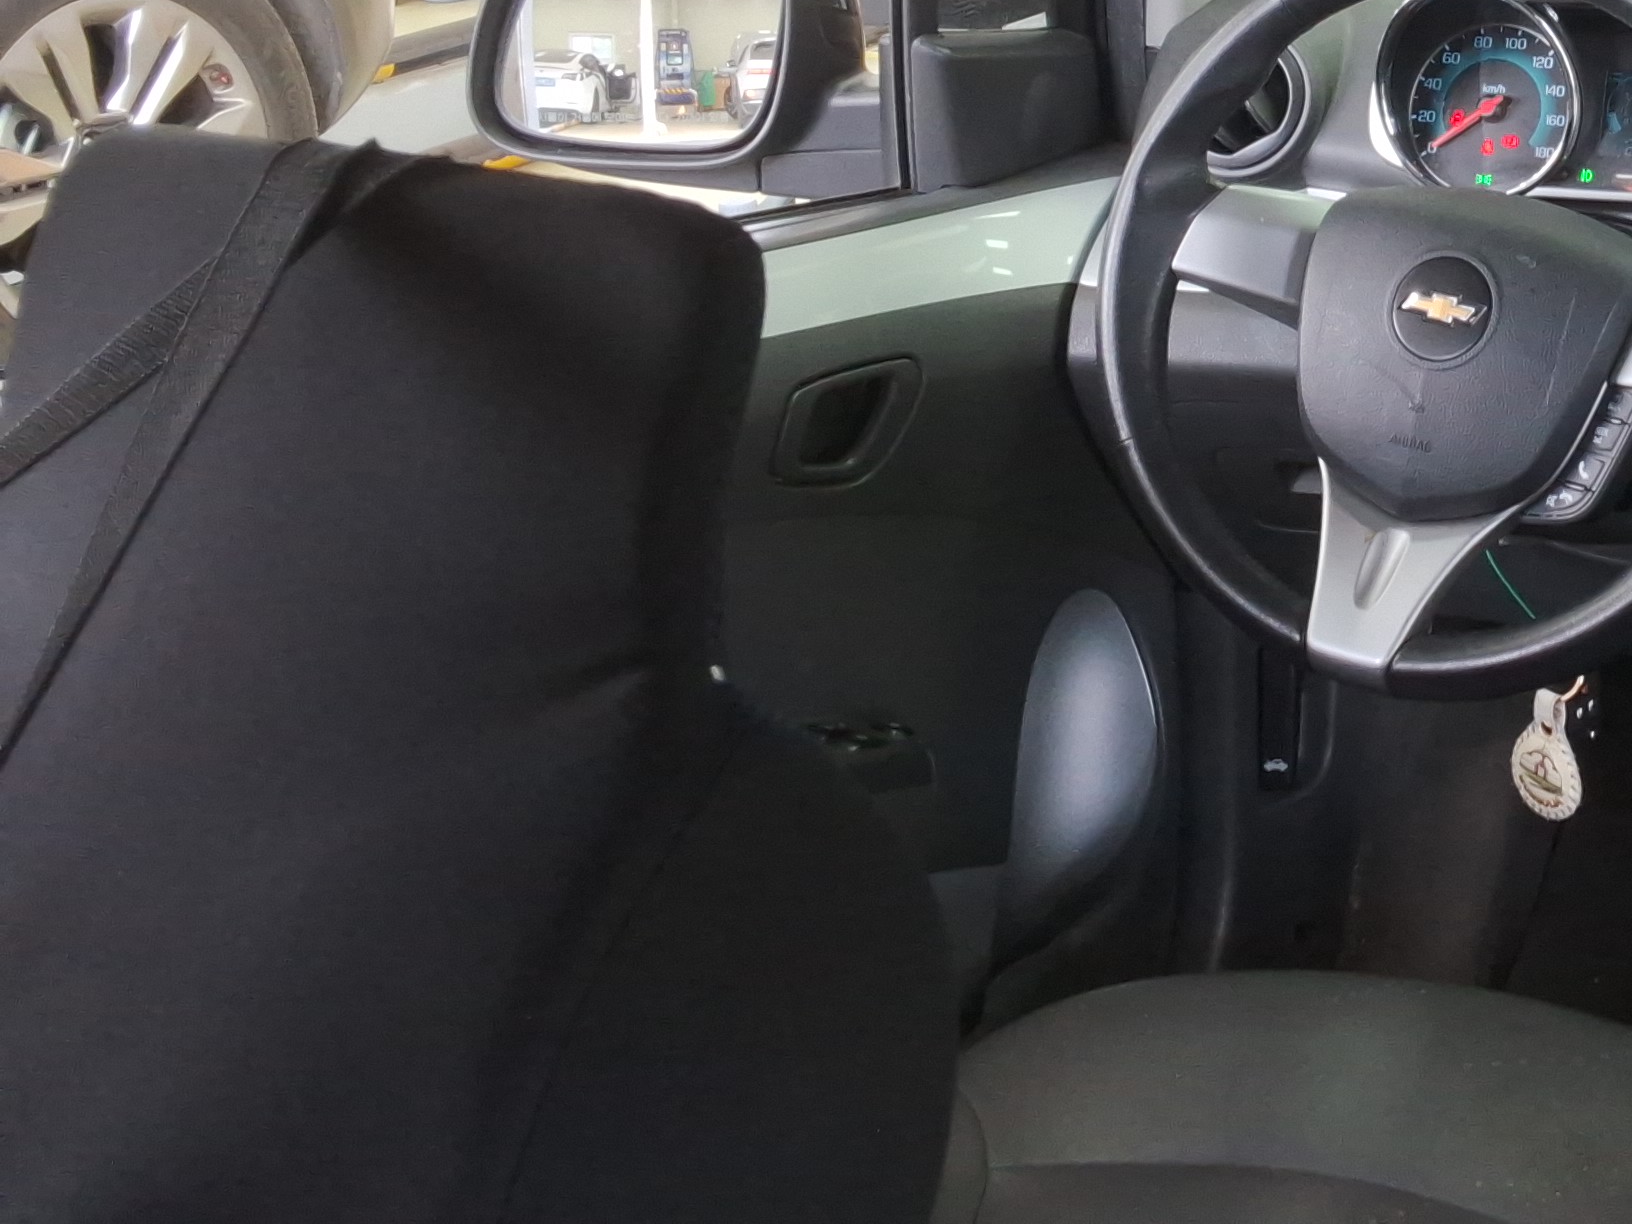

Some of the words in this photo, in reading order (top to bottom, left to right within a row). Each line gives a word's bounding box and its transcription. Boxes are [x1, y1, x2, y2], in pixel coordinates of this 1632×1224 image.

[1474, 36, 1493, 49] 80
[1505, 37, 1527, 50] 100
[1442, 52, 1461, 64] 60
[1532, 56, 1554, 69] 120
[1424, 77, 1442, 90] 40
[1482, 82, 1506, 94] km/h
[1545, 84, 1565, 97] 140
[1418, 110, 1436, 123] 20
[1546, 115, 1565, 127] 160
